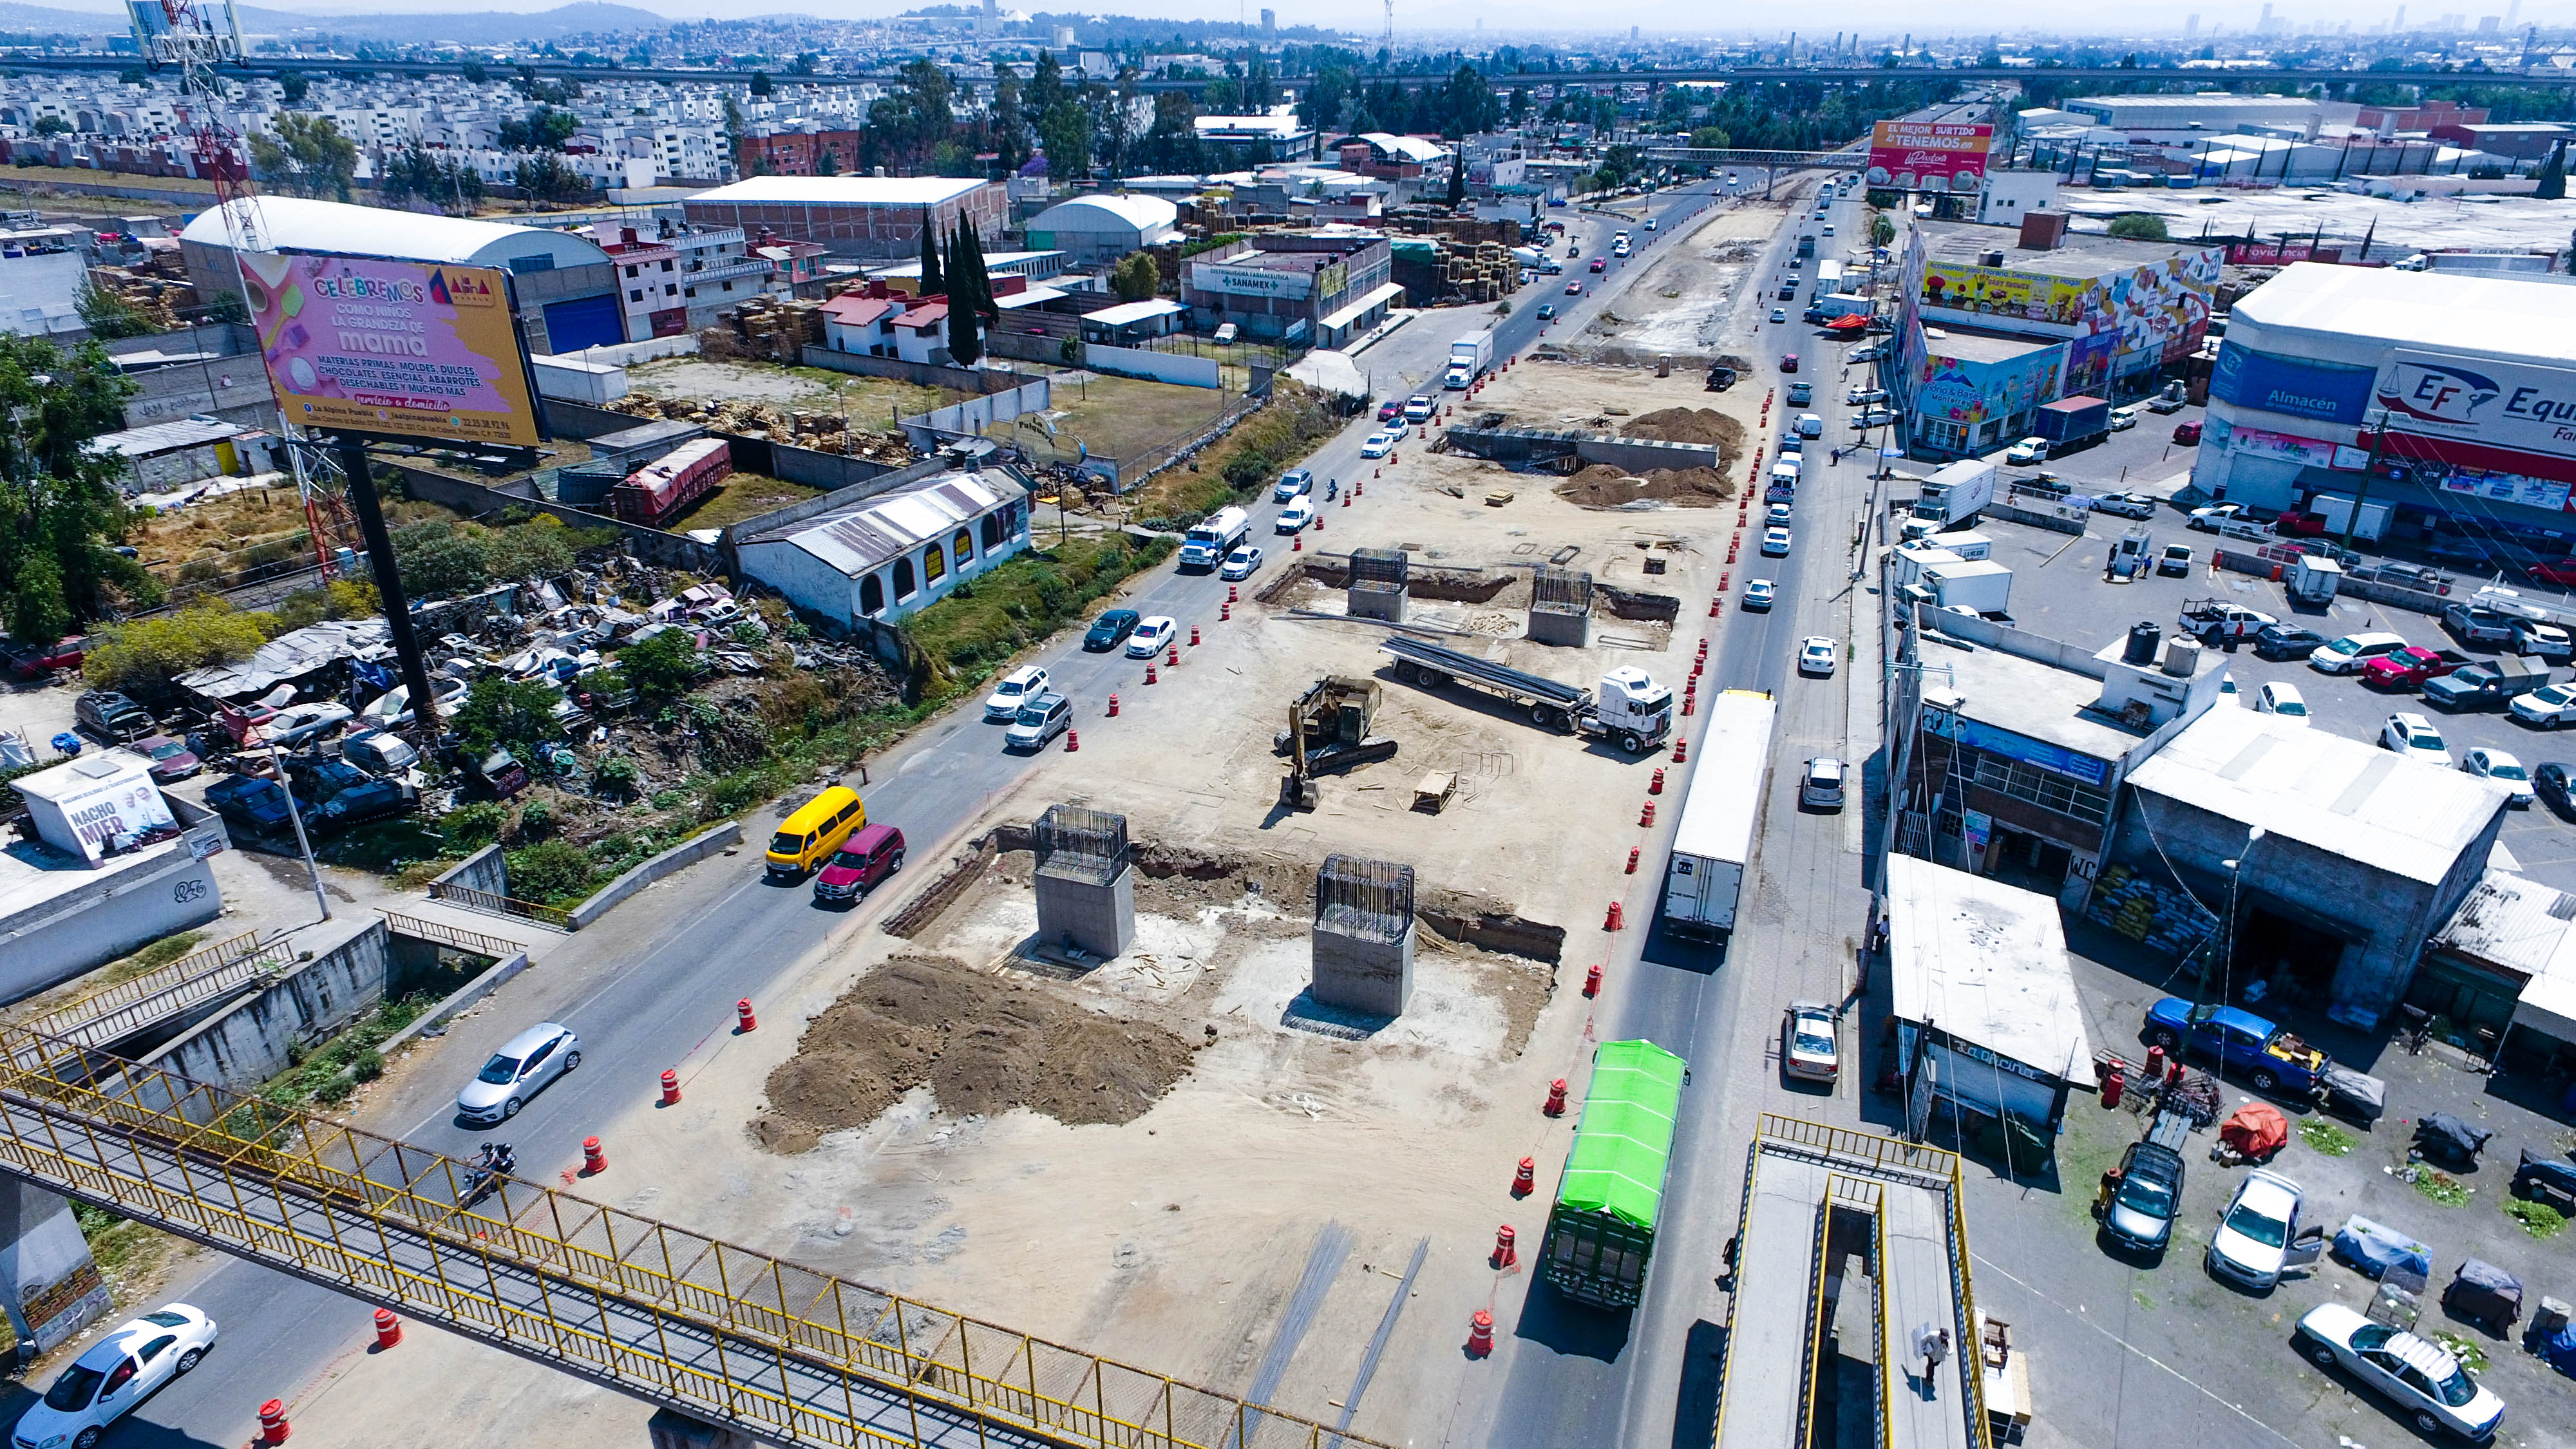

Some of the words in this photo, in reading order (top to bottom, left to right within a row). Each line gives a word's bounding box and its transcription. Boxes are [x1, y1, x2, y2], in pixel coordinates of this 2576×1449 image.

[1888, 124, 1898, 133] EL
[1900, 126, 1931, 135] MEJOR
[1935, 127, 1975, 136] SURTIDO
[1896, 135, 1960, 148] TENEMOS
[1930, 262, 1964, 272] Accesorios
[1966, 265, 1981, 274] para
[314, 276, 424, 305] CELEBREMOS
[1232, 278, 1270, 289] SANAMEX
[336, 303, 372, 316] COMO
[376, 304, 412, 319] NIÑOS
[332, 316, 346, 328] LA
[348, 318, 408, 332] GRANDEZA
[410, 321, 425, 333] DE
[317, 355, 359, 366] MATERIAS
[361, 359, 399, 370] PRIMAS,
[400, 362, 439, 374] MOLDES,
[440, 366, 478, 377] DULCES,
[319, 366, 379, 379] CHOCOLATES,
[381, 372, 426, 384] ESENCIAS,
[429, 375, 484, 388] ABARROTES,
[339, 379, 399, 391] DESECHABLES
[409, 385, 443, 395] MUCHO
[1923, 383, 1947, 395] Vidrio
[1949, 388, 1956, 396] &
[1956, 388, 1984, 402] Bases
[2413, 374, 2461, 410] EF
[355, 395, 392, 406] servicio
[405, 397, 450, 412] domicilio
[1931, 393, 1971, 408] Monterrey
[2268, 389, 2336, 412] Almacén
[324, 406, 346, 415] Alpina
[348, 408, 374, 417] Puebla
[1032, 417, 1043, 428] La
[70, 801, 117, 828] NACHO
[78, 815, 128, 846] MIER
[2070, 855, 2096, 881] WC
